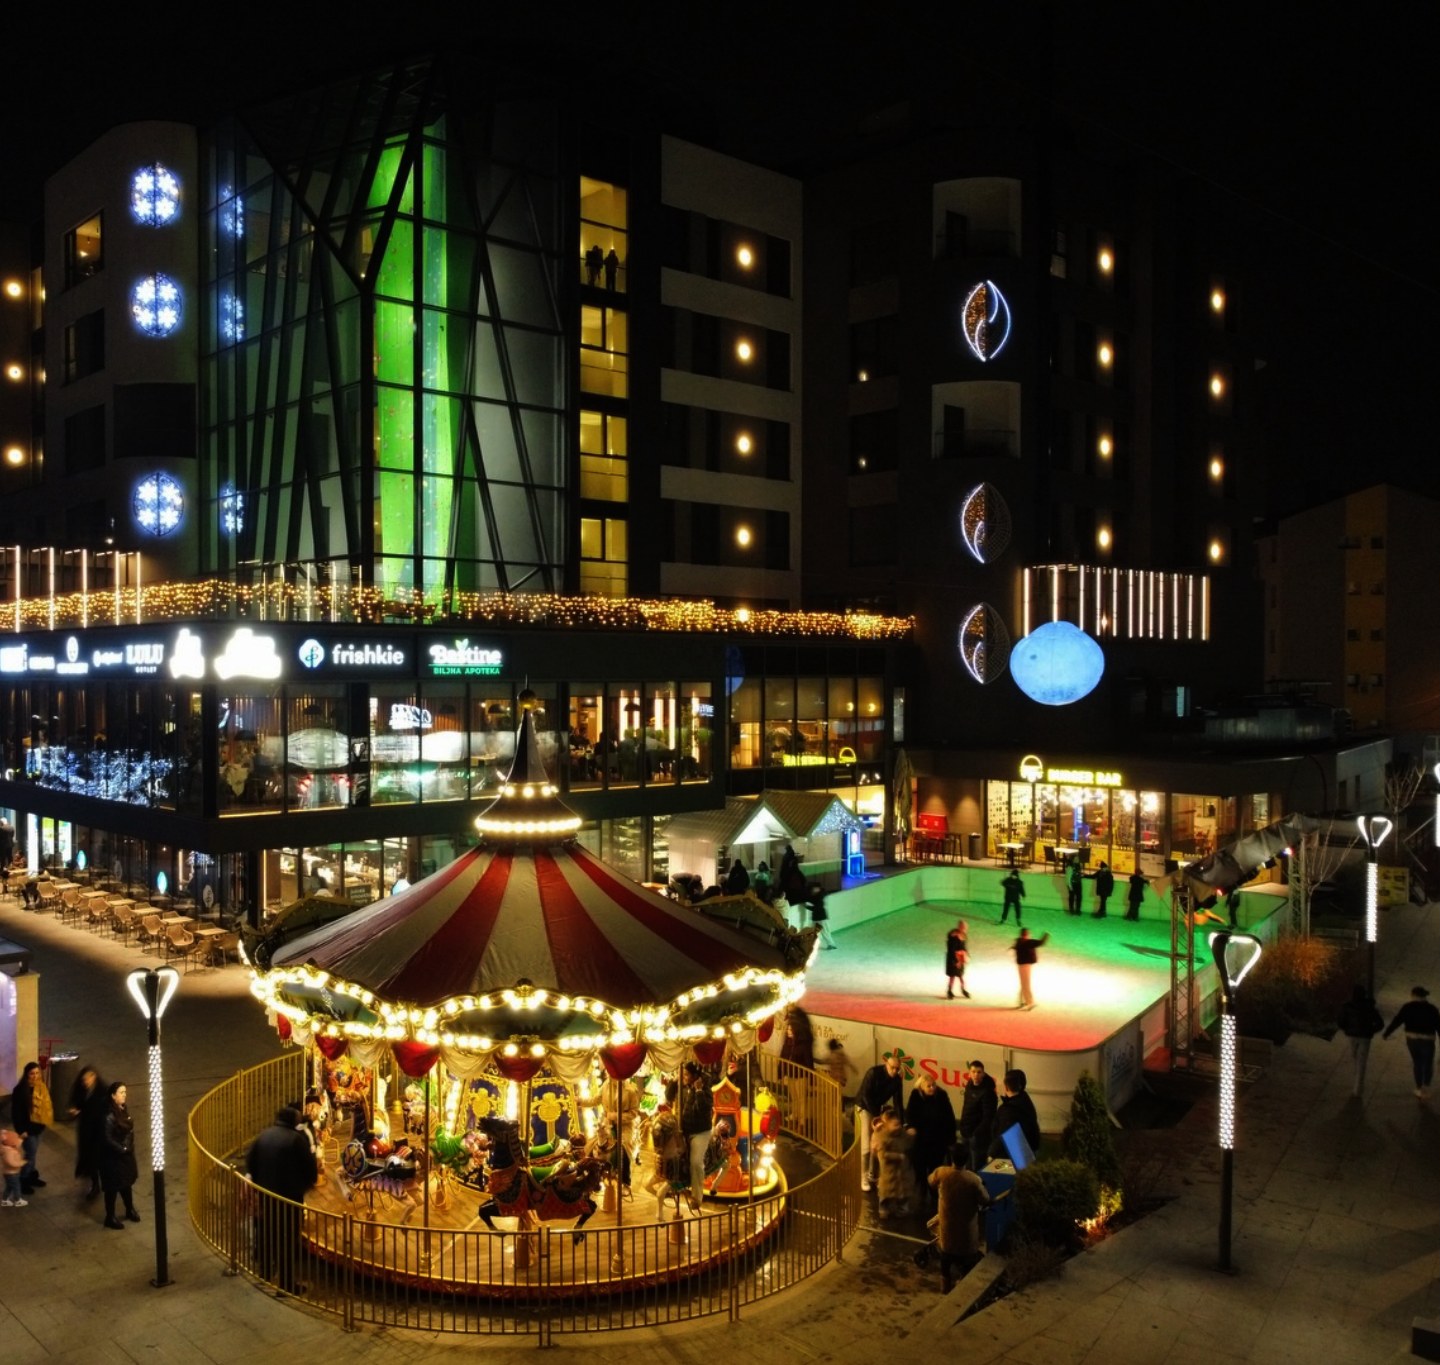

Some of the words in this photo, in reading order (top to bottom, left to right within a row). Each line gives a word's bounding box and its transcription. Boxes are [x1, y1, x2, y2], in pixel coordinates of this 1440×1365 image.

[126, 644, 164, 665] LULU
[332, 644, 404, 665] frishkie
[433, 667, 462, 675] BILJNA
[464, 667, 500, 675] APOTEKA
[1047, 768, 1094, 784] BURGER
[1096, 771, 1122, 786] BAR
